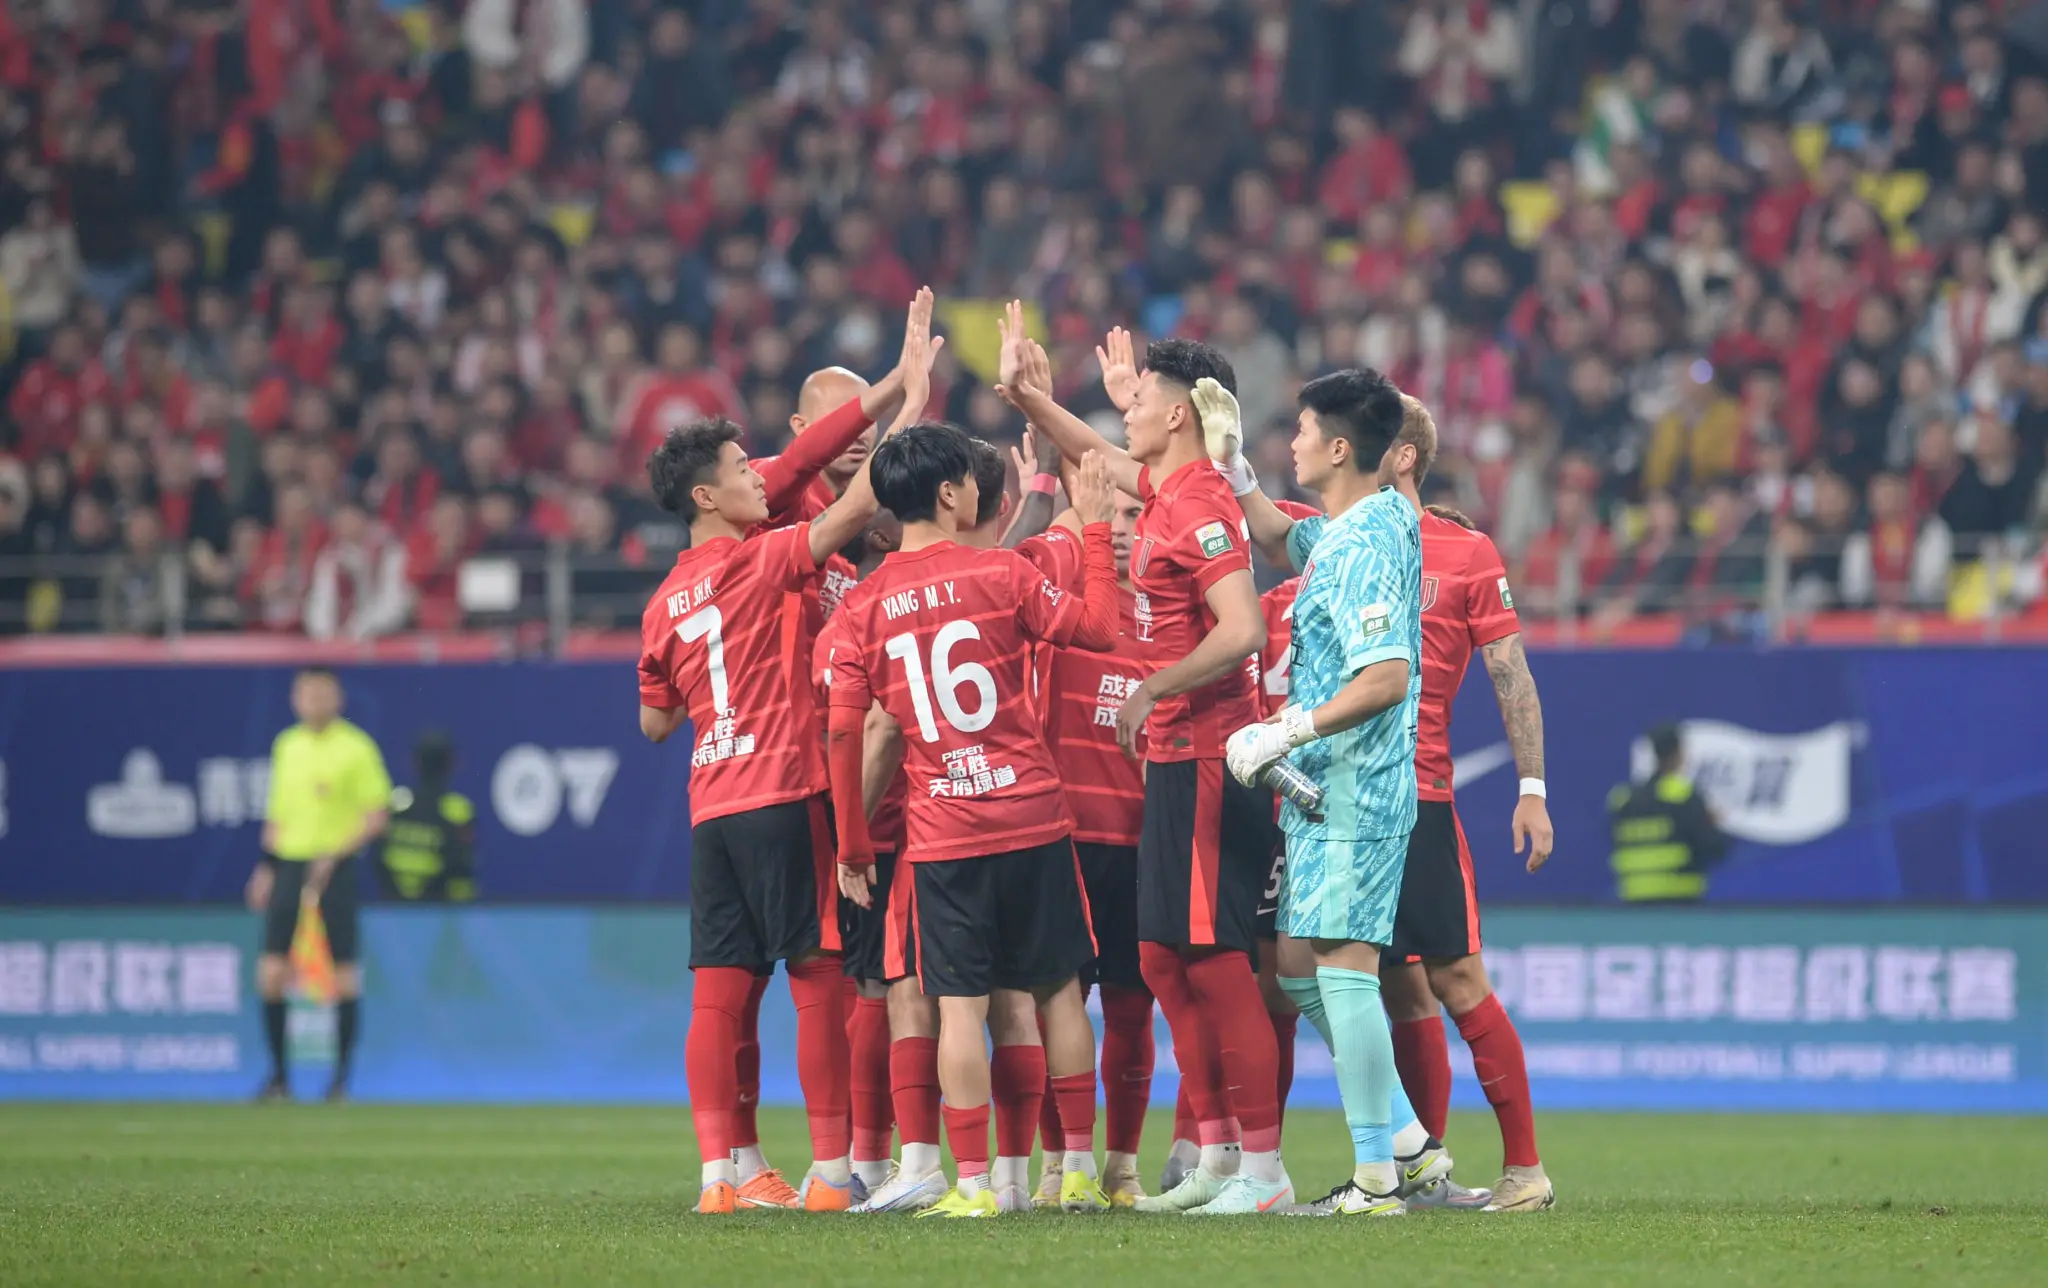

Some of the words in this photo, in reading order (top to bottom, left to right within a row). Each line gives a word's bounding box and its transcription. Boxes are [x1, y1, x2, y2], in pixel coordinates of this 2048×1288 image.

[667, 590, 690, 618] WEI
[881, 589, 919, 620] YANG
[675, 604, 728, 716] 7
[885, 619, 998, 743] 16
[929, 765, 1017, 798] 天府绿道
[947, 754, 990, 780] 品胜
